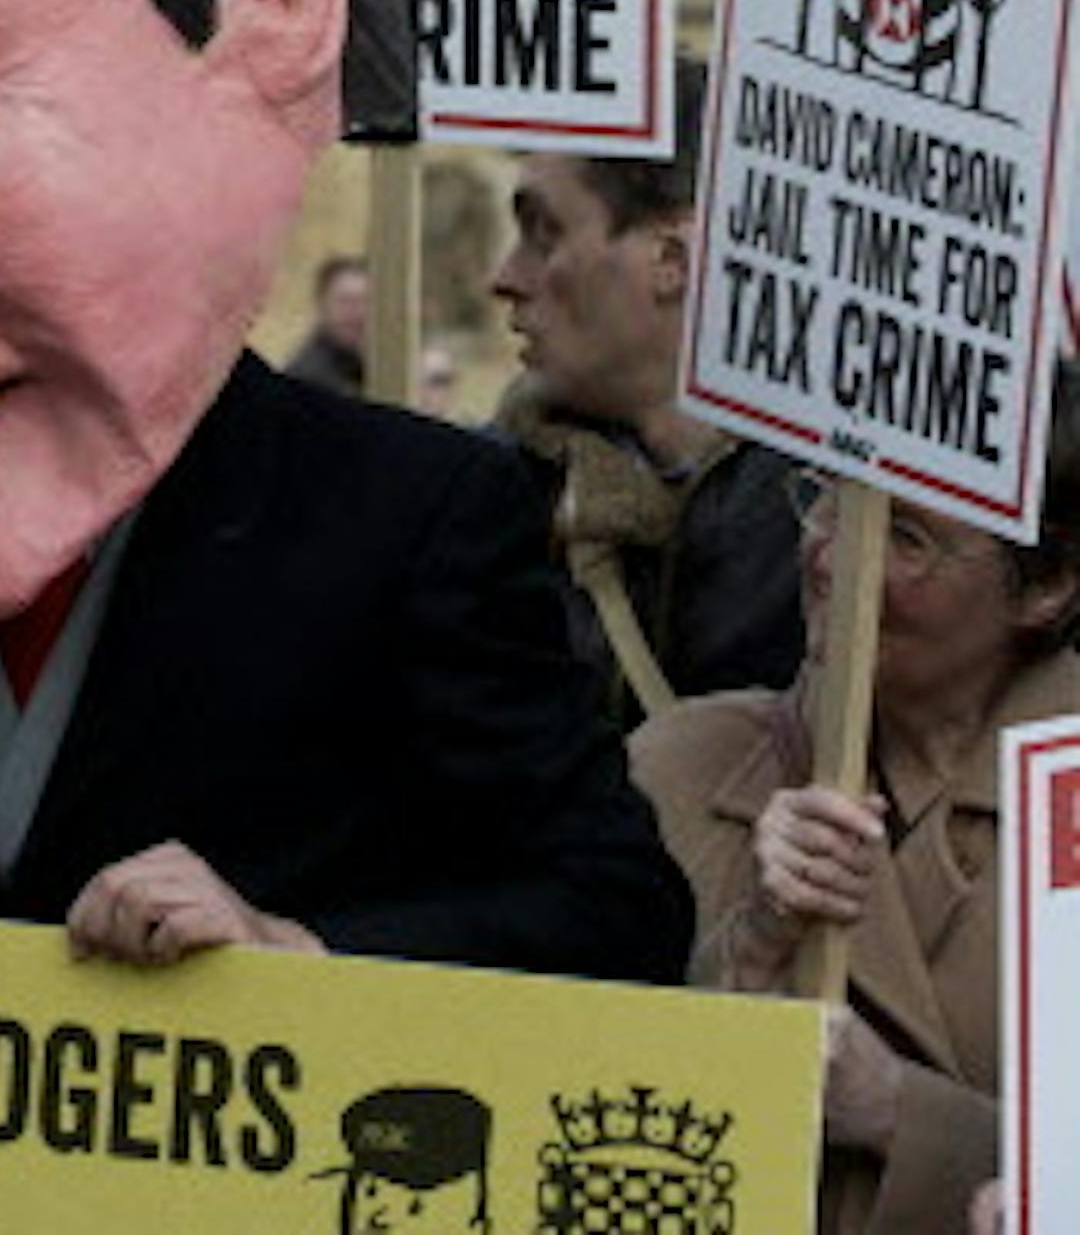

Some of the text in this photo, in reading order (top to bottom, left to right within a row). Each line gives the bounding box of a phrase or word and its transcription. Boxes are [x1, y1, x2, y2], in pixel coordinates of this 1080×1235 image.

[736, 75, 1025, 235] DAVID CAMERON:
[729, 168, 1018, 339] JAIL TIME FOR
[723, 259, 1010, 463] TAX CRIME
